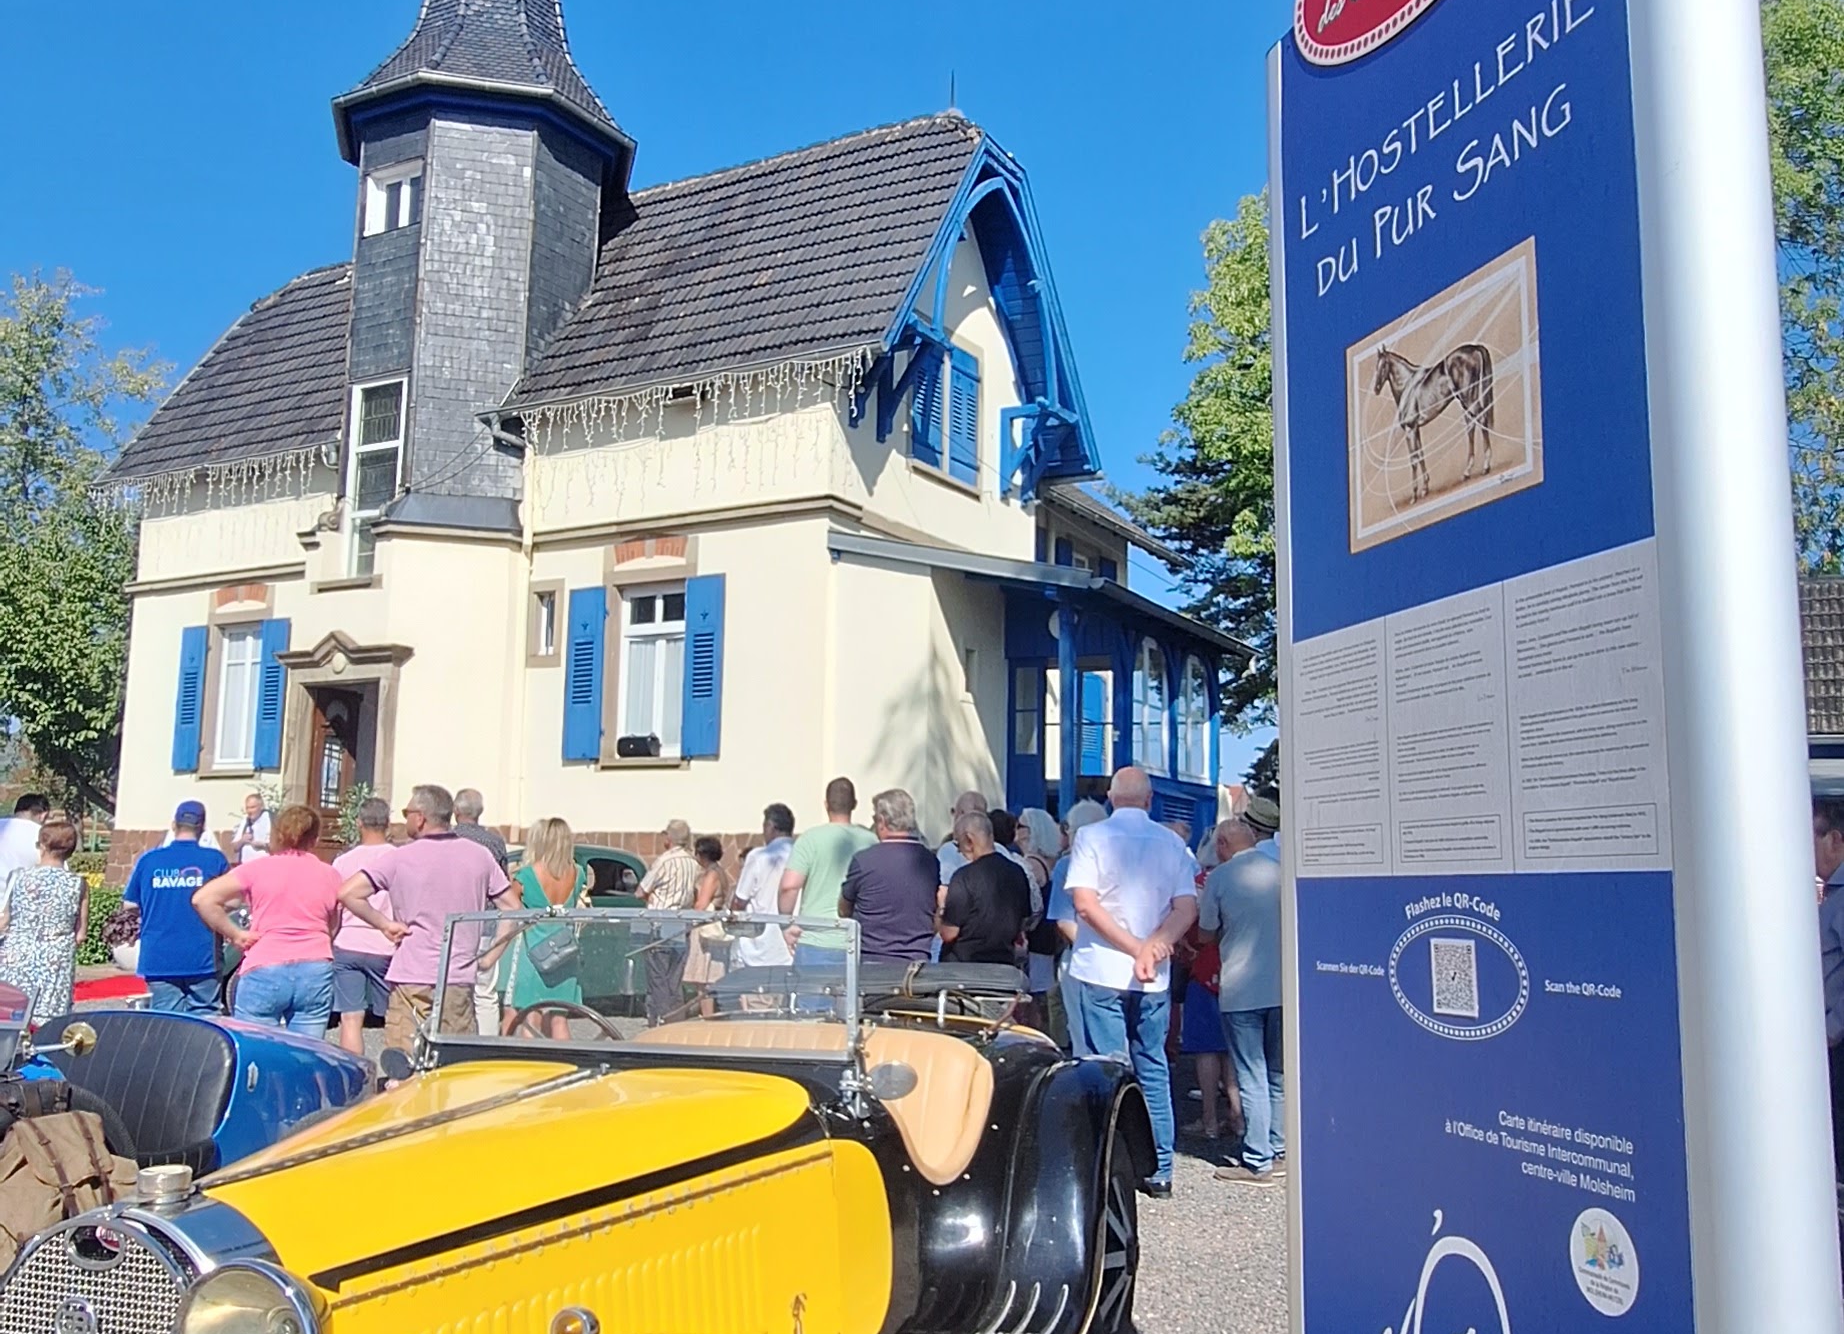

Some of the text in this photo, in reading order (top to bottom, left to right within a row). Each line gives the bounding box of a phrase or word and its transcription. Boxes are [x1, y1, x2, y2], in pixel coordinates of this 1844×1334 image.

[1317, 83, 1573, 297] DU PUR SANG
[152, 876, 204, 889] RAVAGE
[153, 868, 180, 878] CLUB
[1405, 892, 1501, 921] Flashez le QR-Code
[1359, 963, 1385, 976] QR-Code
[1544, 979, 1622, 998] Scan the QR-Code
[1498, 1110, 1634, 1155] Carte itinéraire disponible
[1445, 1119, 1635, 1180] à l'Office de Tourisme Intercommunal,
[1521, 1161, 1636, 1203] centre-ville Molsheim
